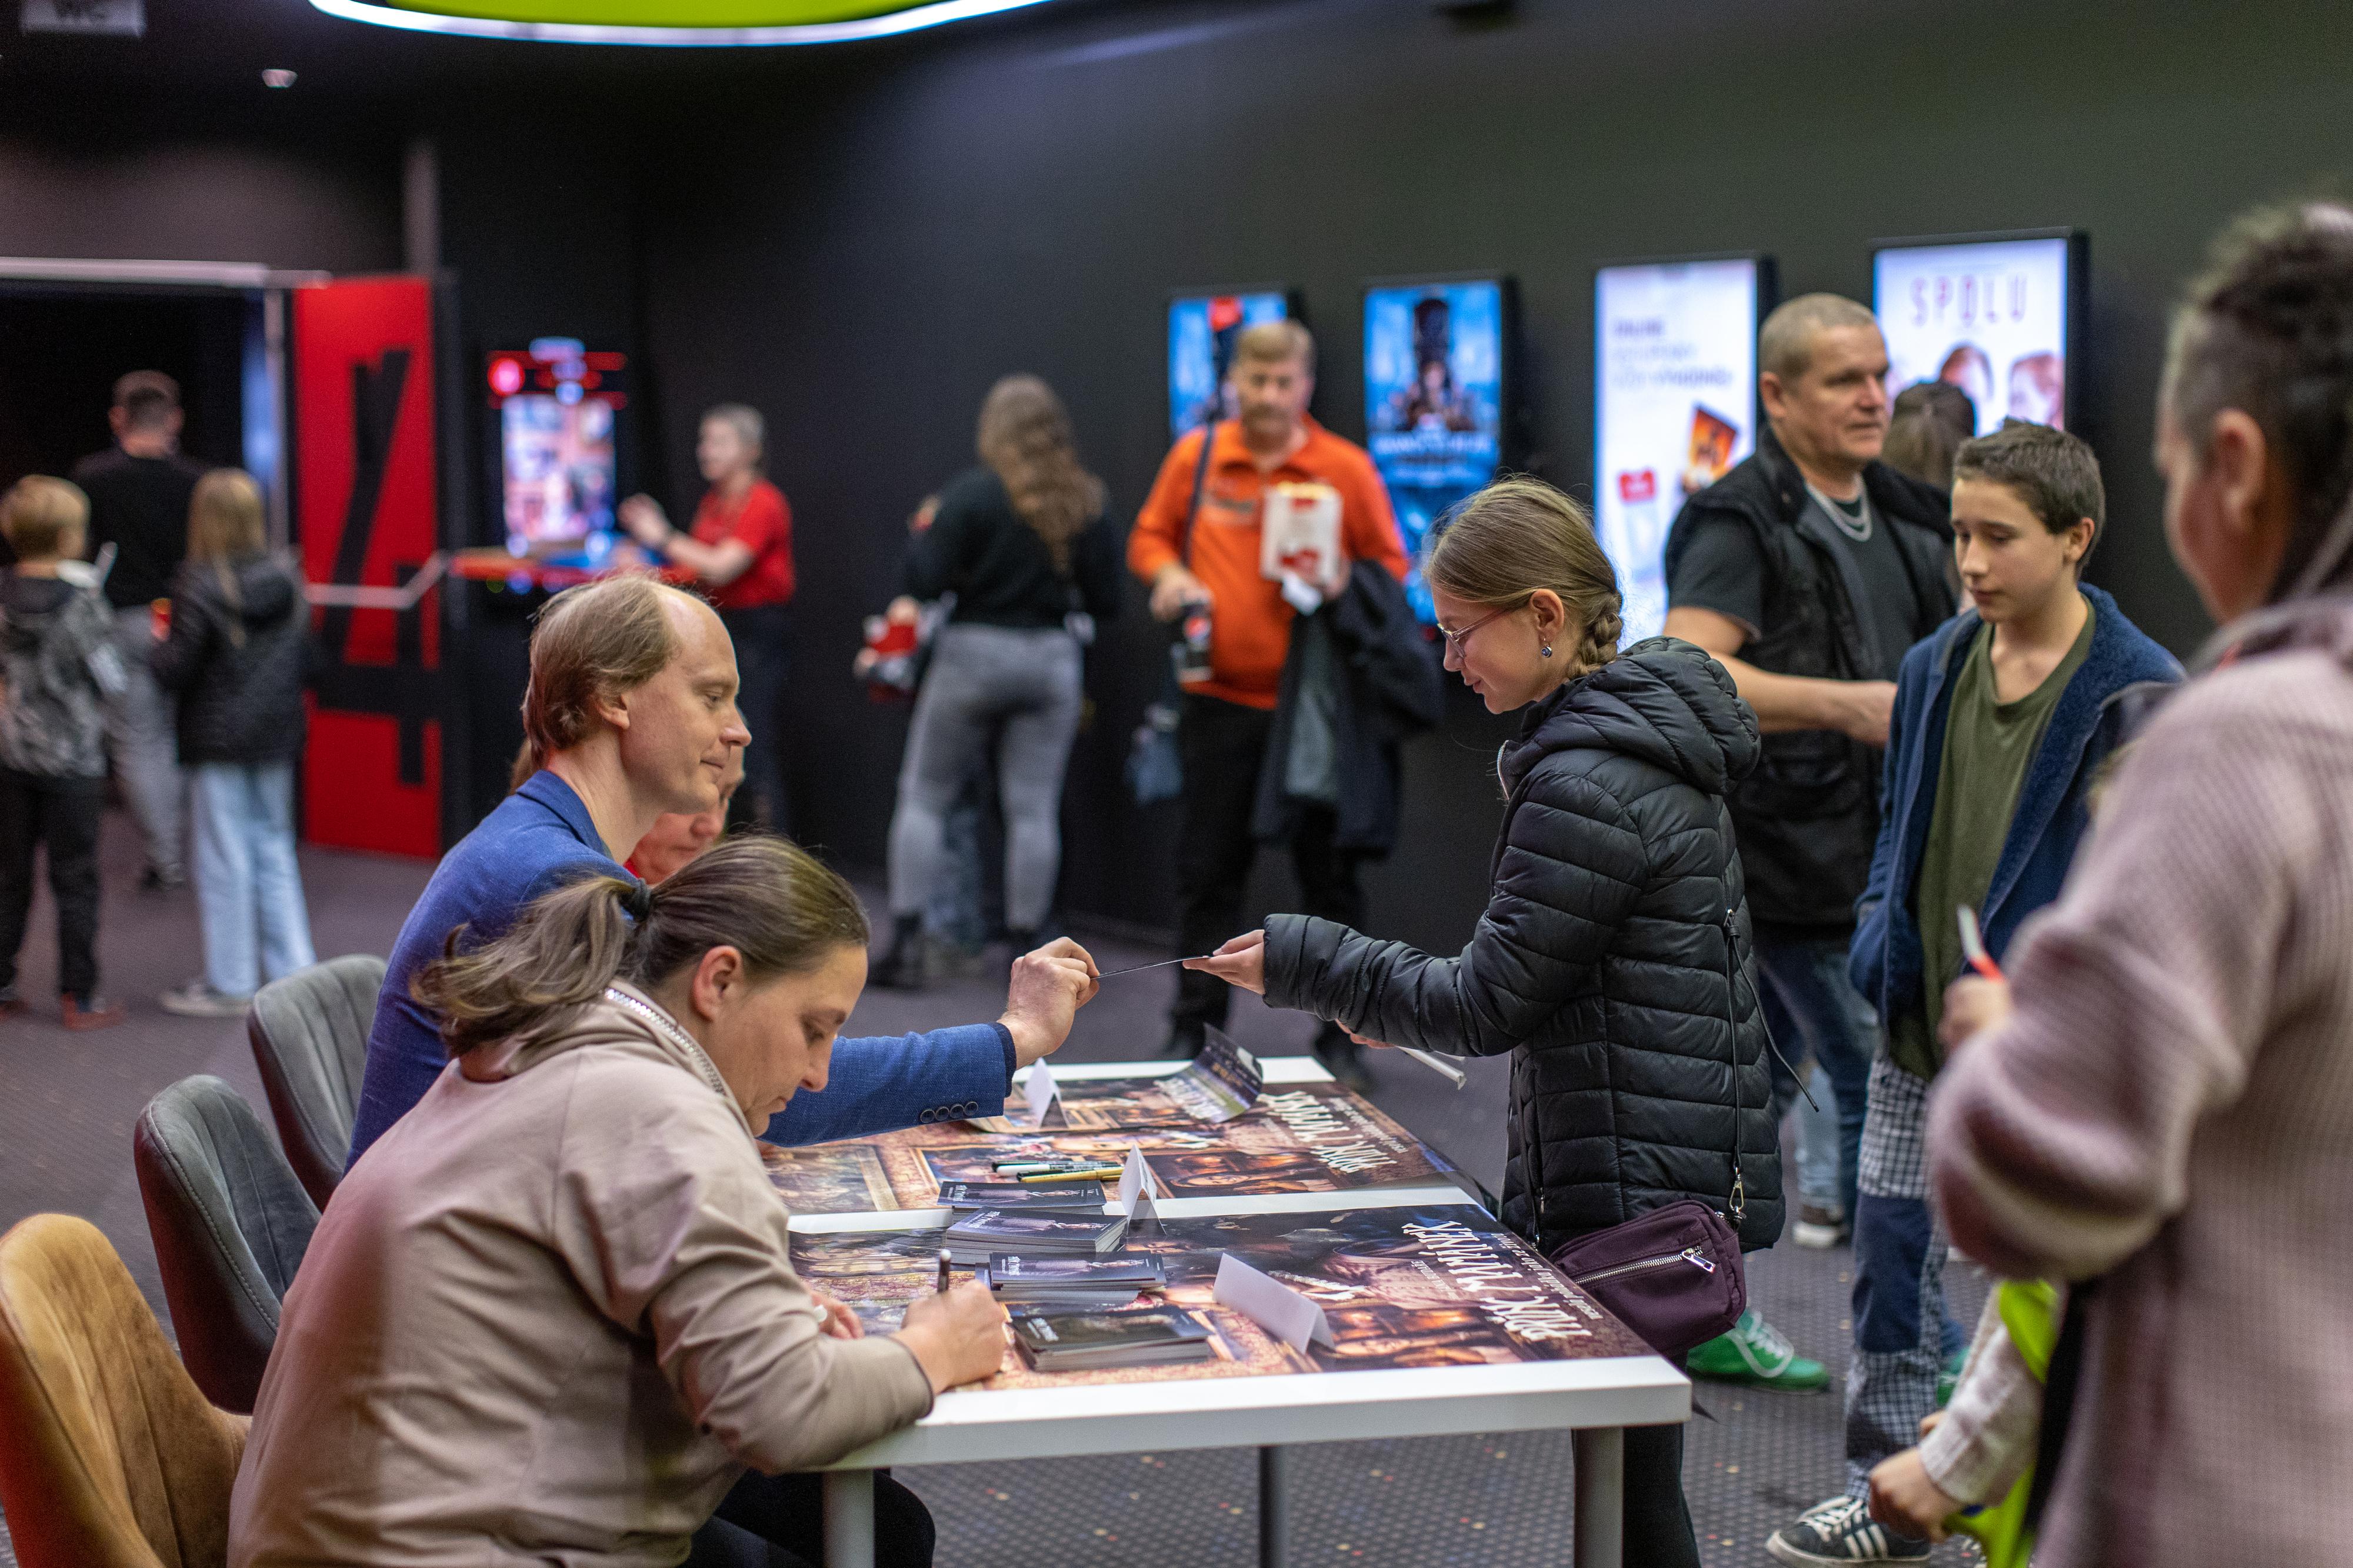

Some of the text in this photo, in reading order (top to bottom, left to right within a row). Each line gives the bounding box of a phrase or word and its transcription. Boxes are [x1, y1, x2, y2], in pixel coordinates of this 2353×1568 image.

[1910, 275, 2027, 327] SPOLU
[1490, 1233, 1521, 1249] života
[1411, 1260, 1441, 1279] BUDAŘE
[1521, 1257, 1553, 1272] jako
[1401, 1220, 1592, 1342] PRINC MAMÁNEK
[1537, 1272, 1584, 1299] pohádka
